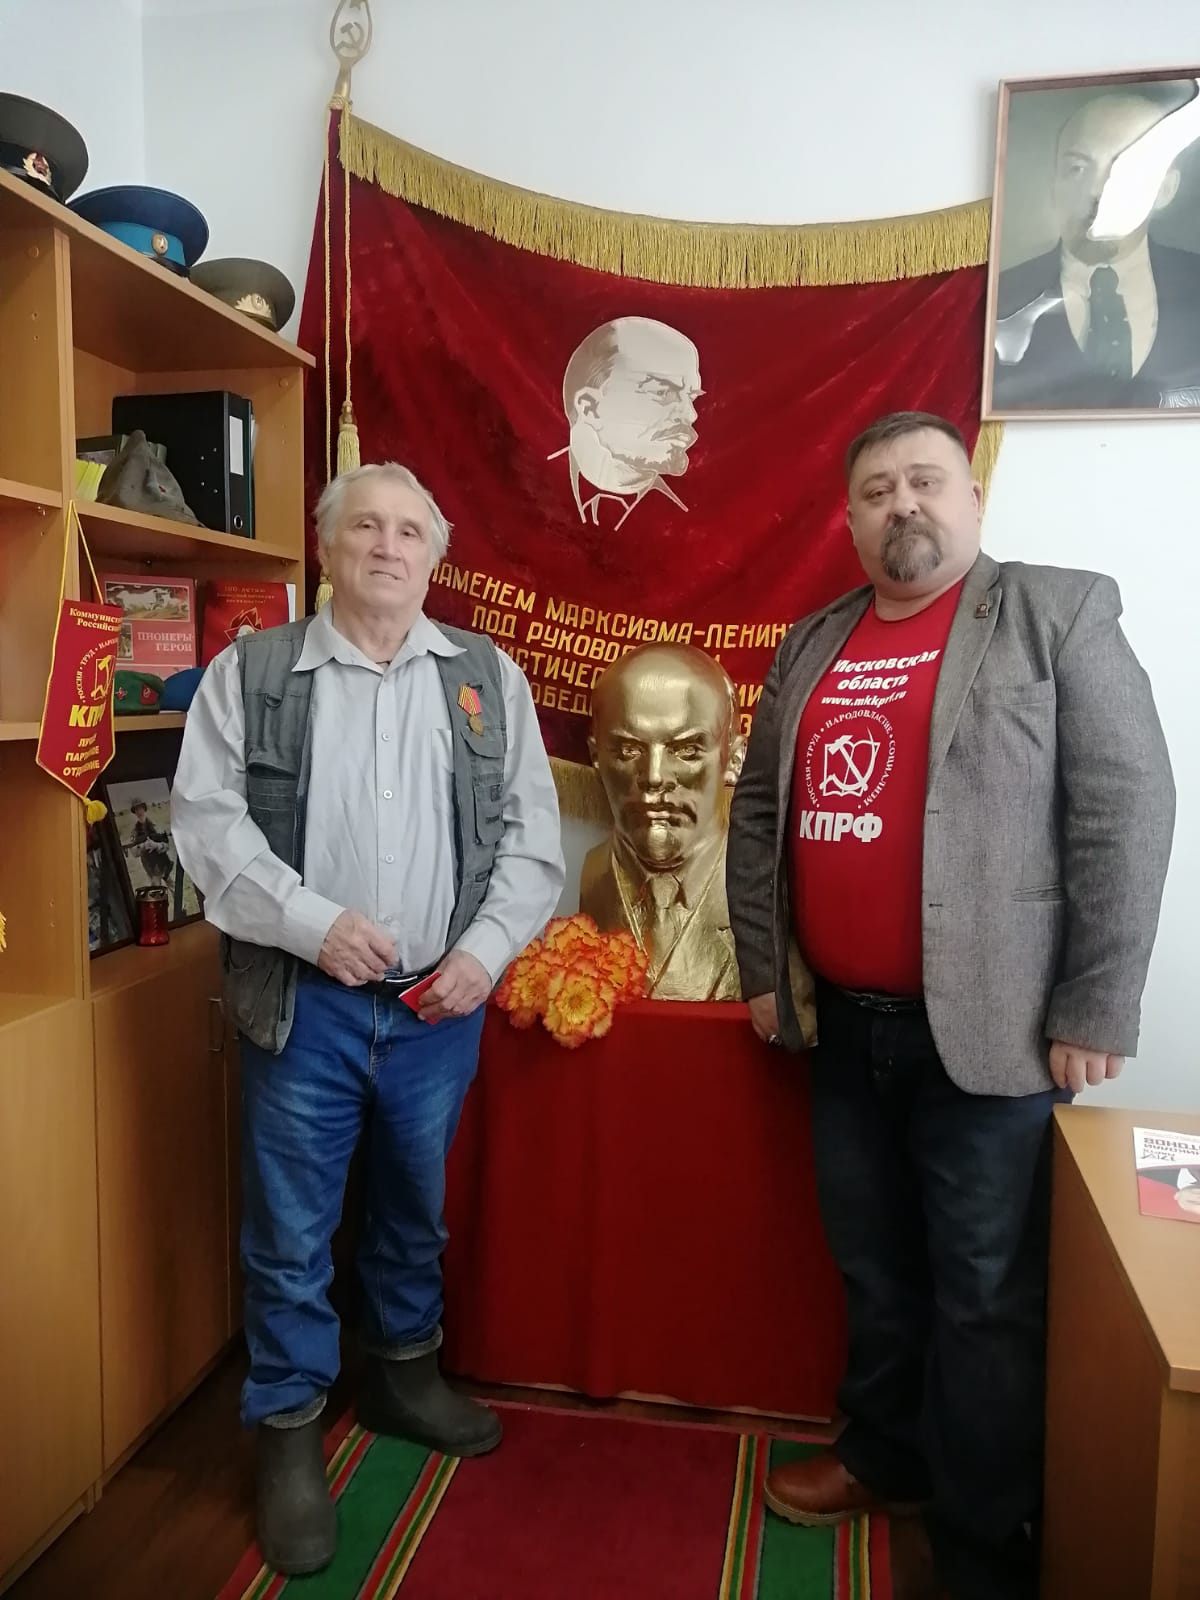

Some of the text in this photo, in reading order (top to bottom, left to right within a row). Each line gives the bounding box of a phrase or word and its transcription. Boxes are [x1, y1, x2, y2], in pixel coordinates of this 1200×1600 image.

[76, 618, 121, 632] Российс
[471, 605, 517, 639] ПОД
[545, 597, 794, 648] МАРКСИЗМА-ЛЕНИН
[155, 642, 193, 652] ГЕРОИ
[831, 649, 941, 673] Московская
[837, 674, 909, 690] область
[530, 682, 593, 717] ОБЕД
[821, 690, 907, 708] www.mkkprf.ru
[825, 709, 893, 735] НАРОДОВЛАСТИЕ
[806, 733, 821, 758] ТРУД
[805, 766, 818, 805] РОССИЯ
[799, 810, 883, 843] КПРФ
[1143, 1137, 1200, 1151] ТОНОВ
